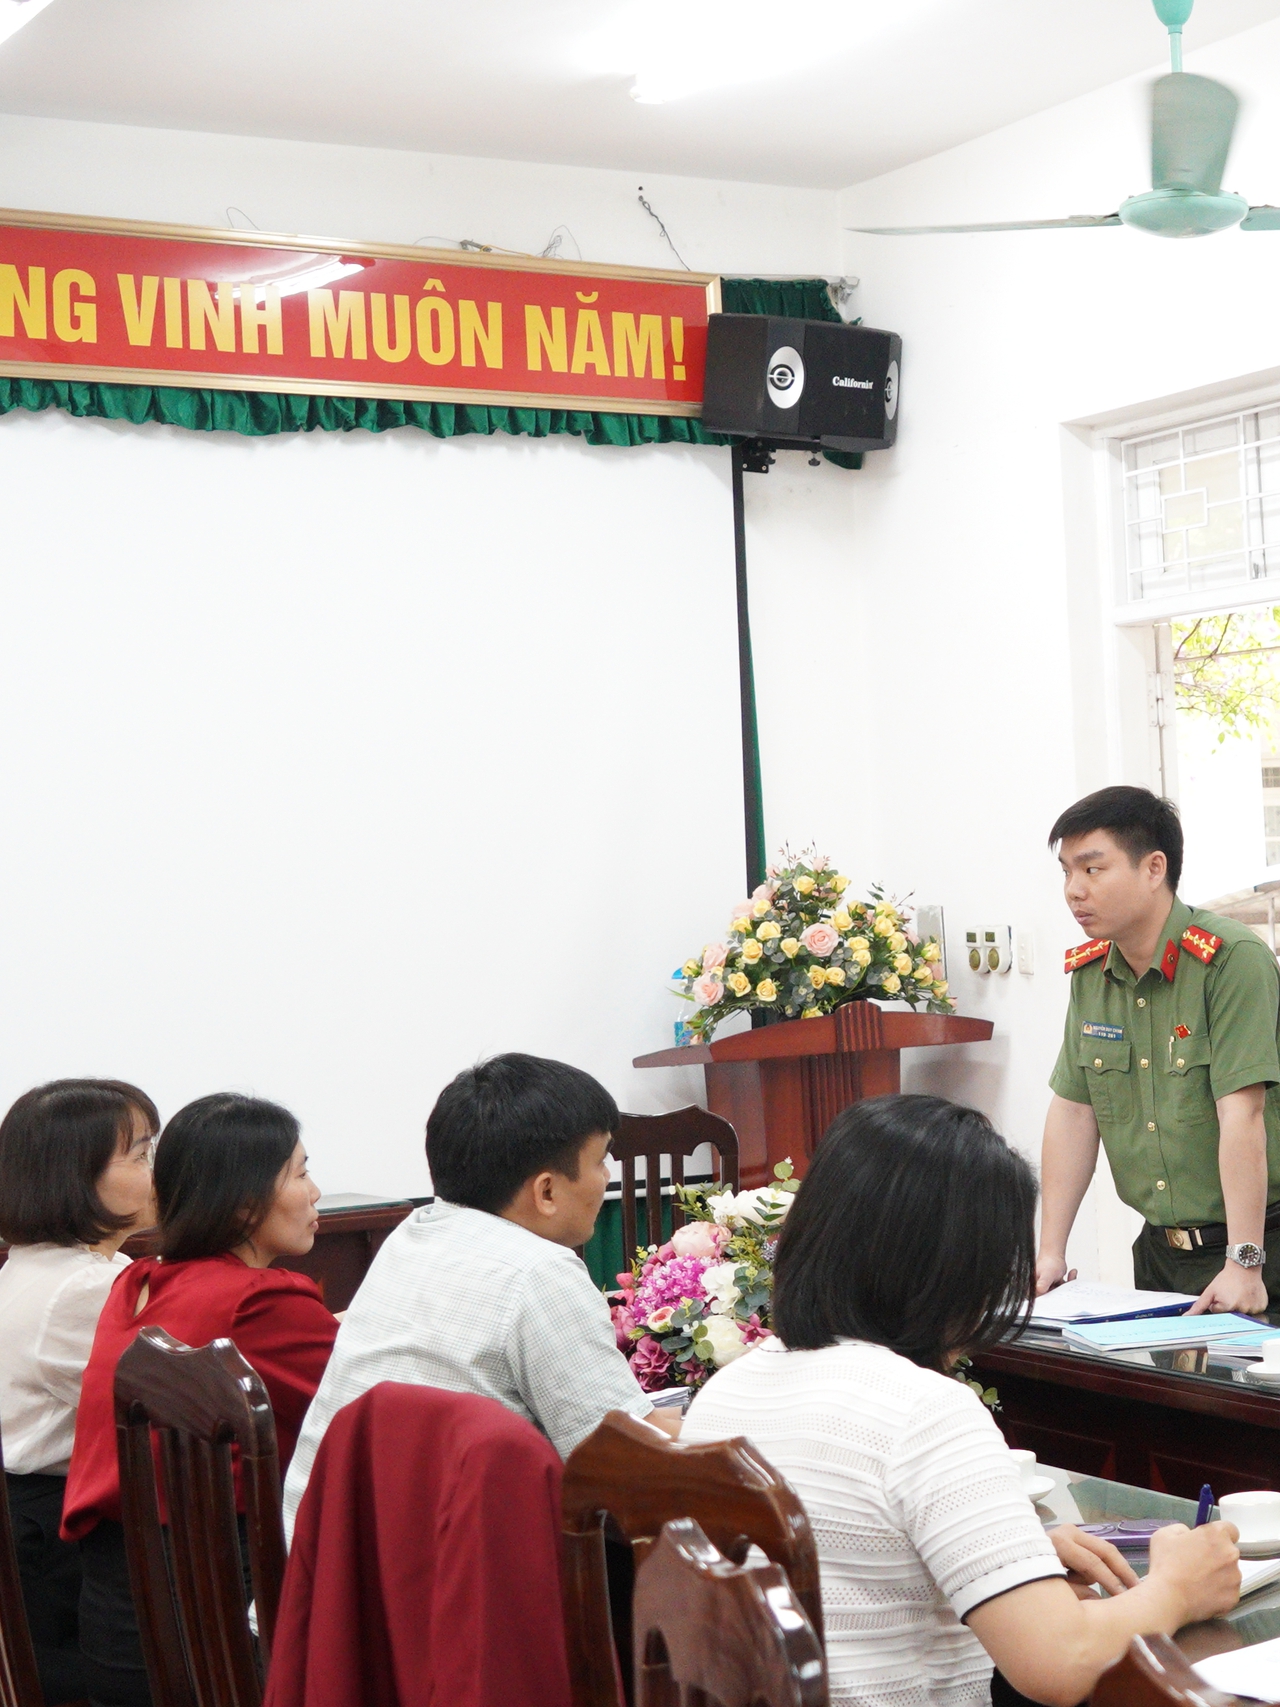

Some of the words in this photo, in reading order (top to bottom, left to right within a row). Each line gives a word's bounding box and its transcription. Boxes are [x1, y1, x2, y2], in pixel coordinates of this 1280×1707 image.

[118, 274, 285, 357] VINH
[309, 279, 503, 369] MUÔN
[525, 291, 686, 380] NĂM!
